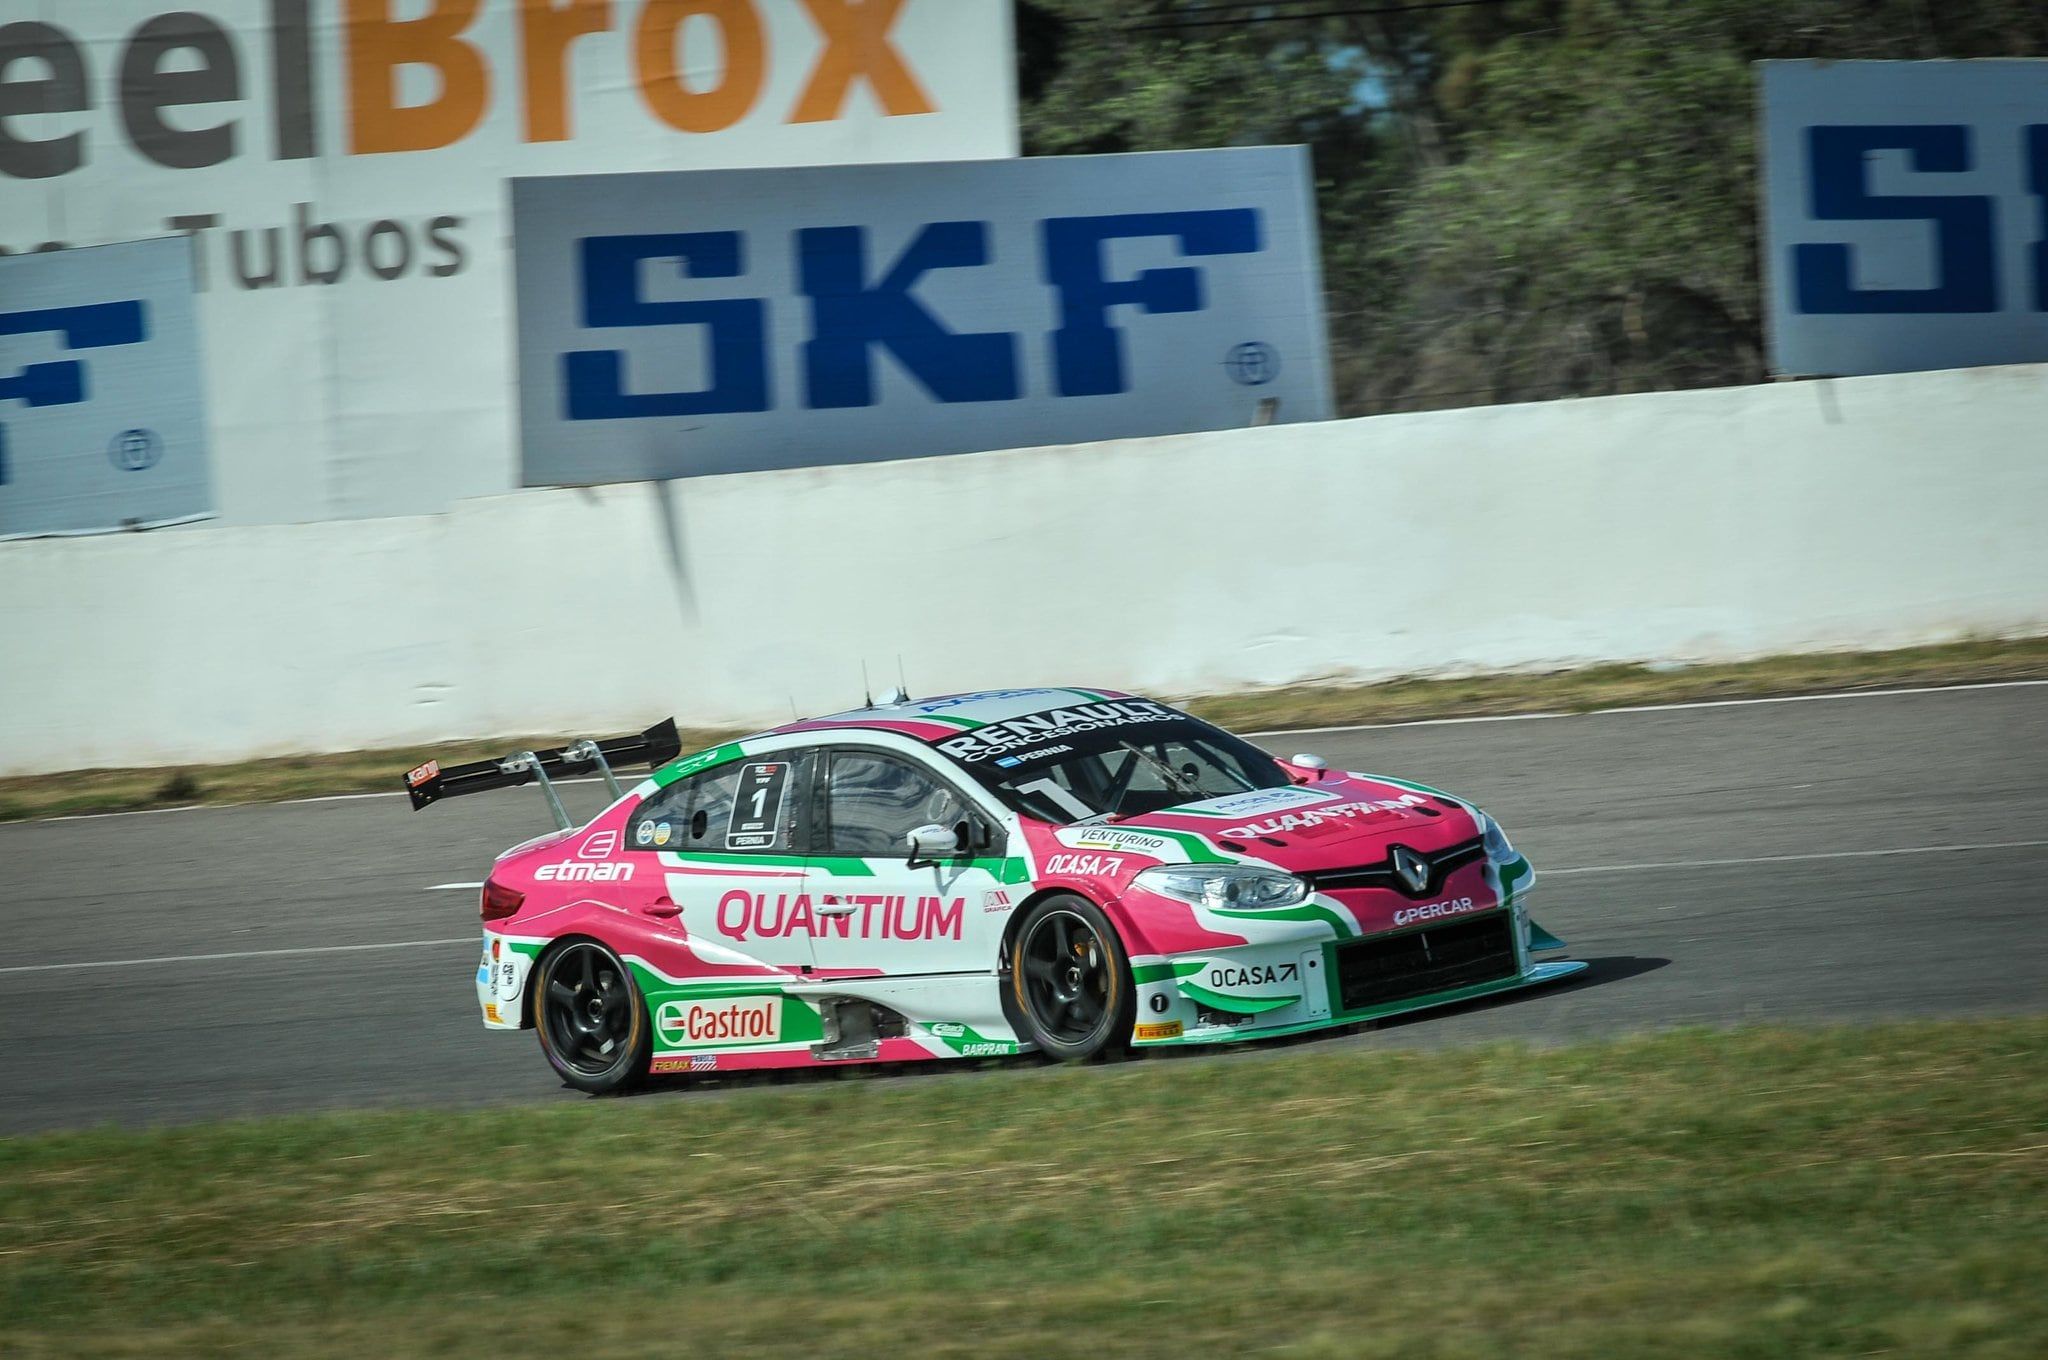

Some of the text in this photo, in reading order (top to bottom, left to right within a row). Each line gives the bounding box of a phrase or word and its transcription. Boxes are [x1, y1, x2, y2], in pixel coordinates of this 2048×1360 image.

[1793, 124, 2048, 315] S
[166, 202, 470, 292] Tubos
[561, 207, 1264, 421] SKF
[936, 702, 1166, 759] RENAULT
[964, 713, 1187, 763] CONCESIONARIOS
[1018, 744, 1074, 762] PERNIA
[751, 788, 768, 818] 1
[1015, 777, 1098, 820] 1
[1080, 829, 1164, 848] VENTURINO
[533, 858, 636, 882] etman
[1045, 854, 1102, 876] OCASA
[716, 889, 966, 942] QUANTIUM
[1210, 965, 1277, 988] OCASA
[688, 1002, 776, 1040] Castrol
